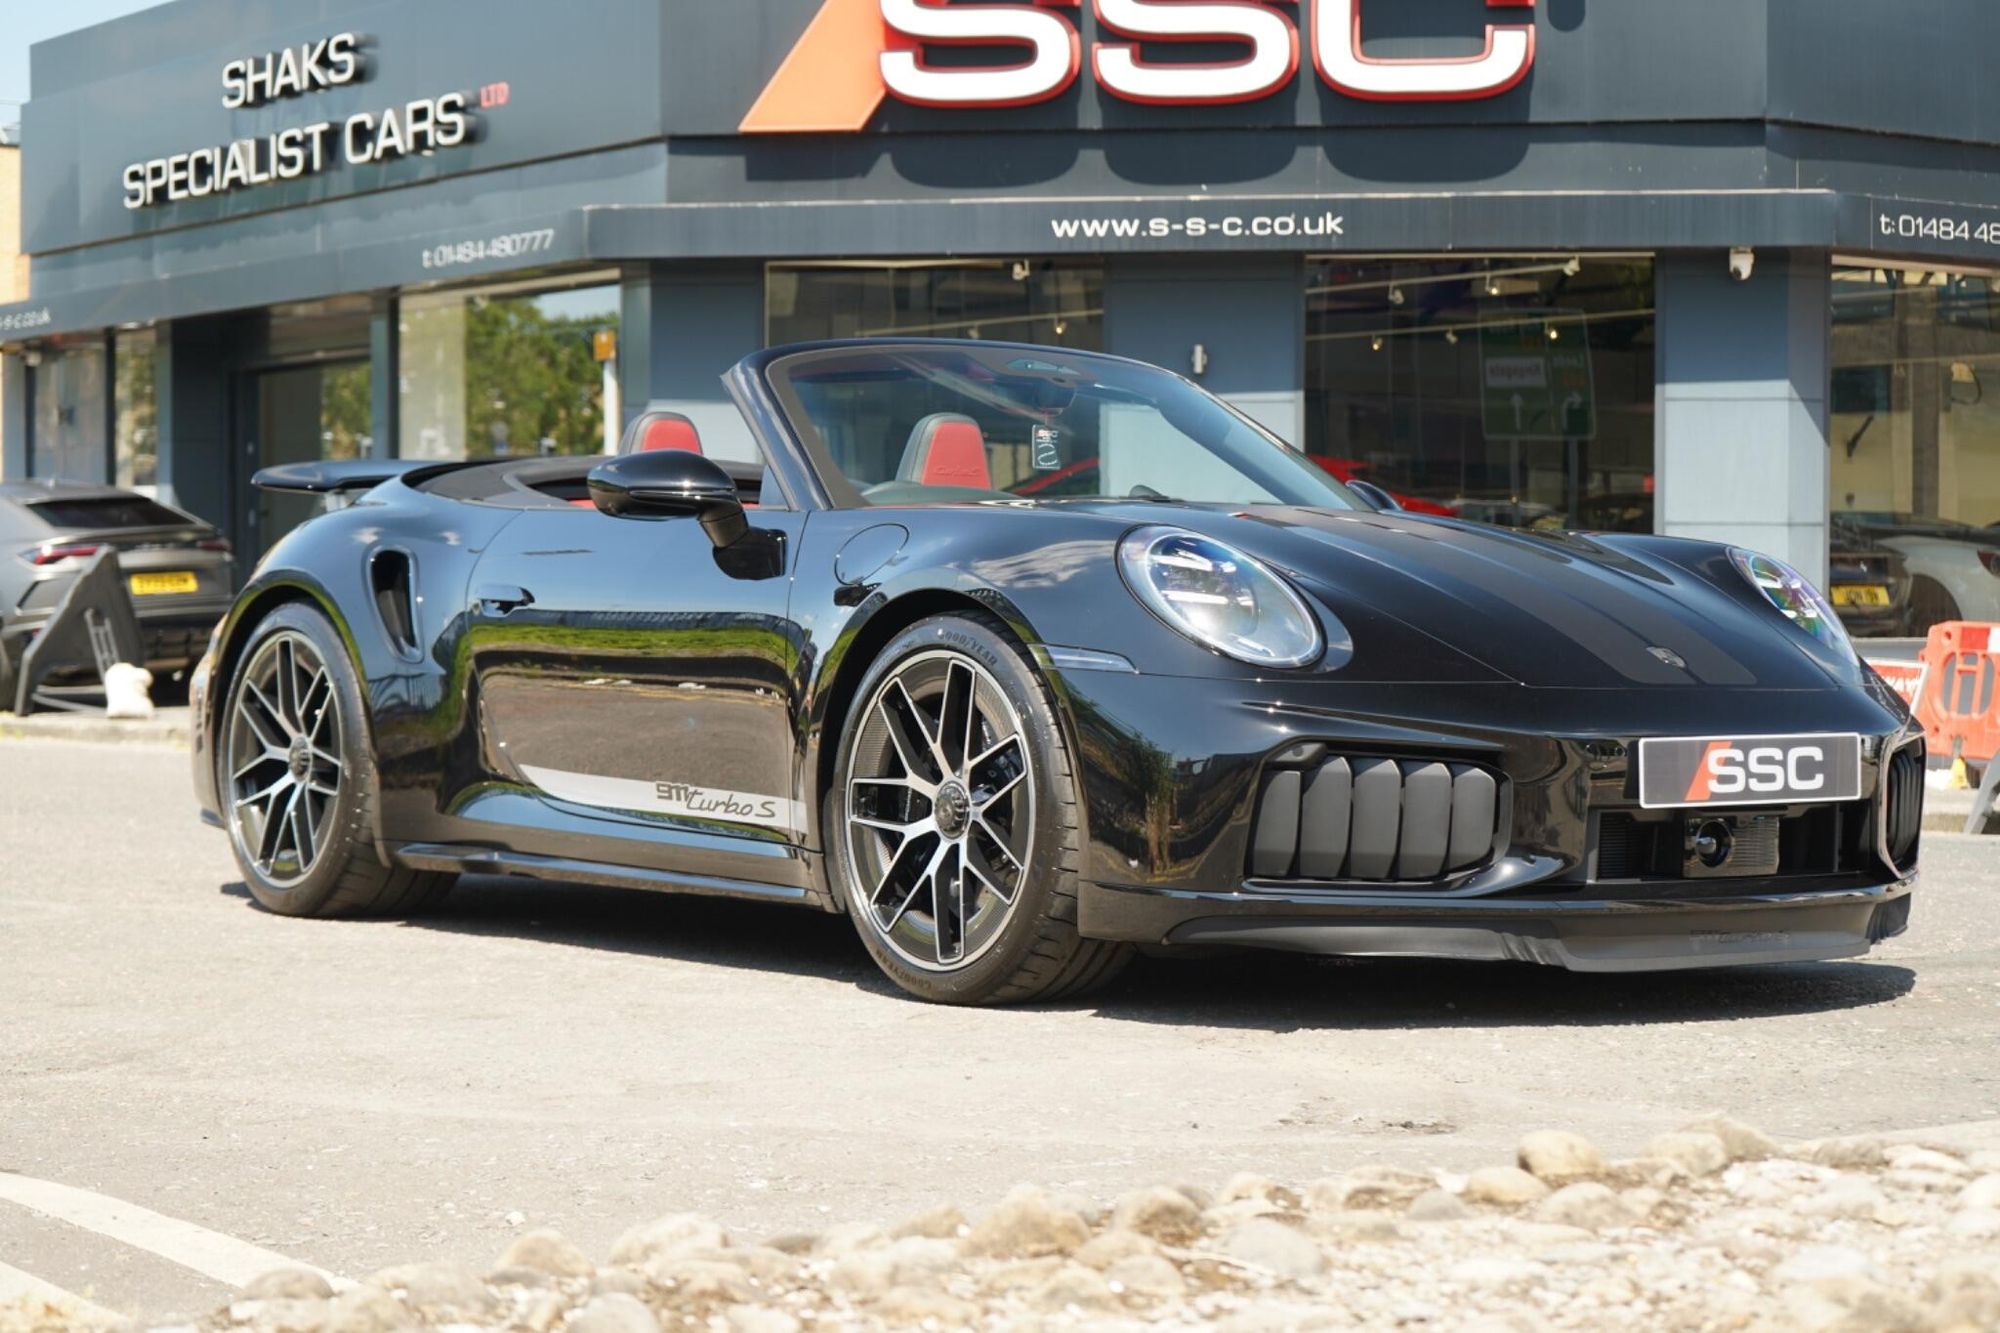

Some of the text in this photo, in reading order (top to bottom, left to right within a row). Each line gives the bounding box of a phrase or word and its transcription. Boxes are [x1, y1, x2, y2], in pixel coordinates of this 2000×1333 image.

[221, 32, 358, 108] SHAKS
[879, 0, 1535, 105] SSC
[122, 82, 509, 209] SPECIALIST CARS LTD
[1051, 211, 1344, 241] www.s-s-c.co.uk
[656, 782, 777, 818] 911 turbo S
[1707, 746, 1824, 794] SSC
